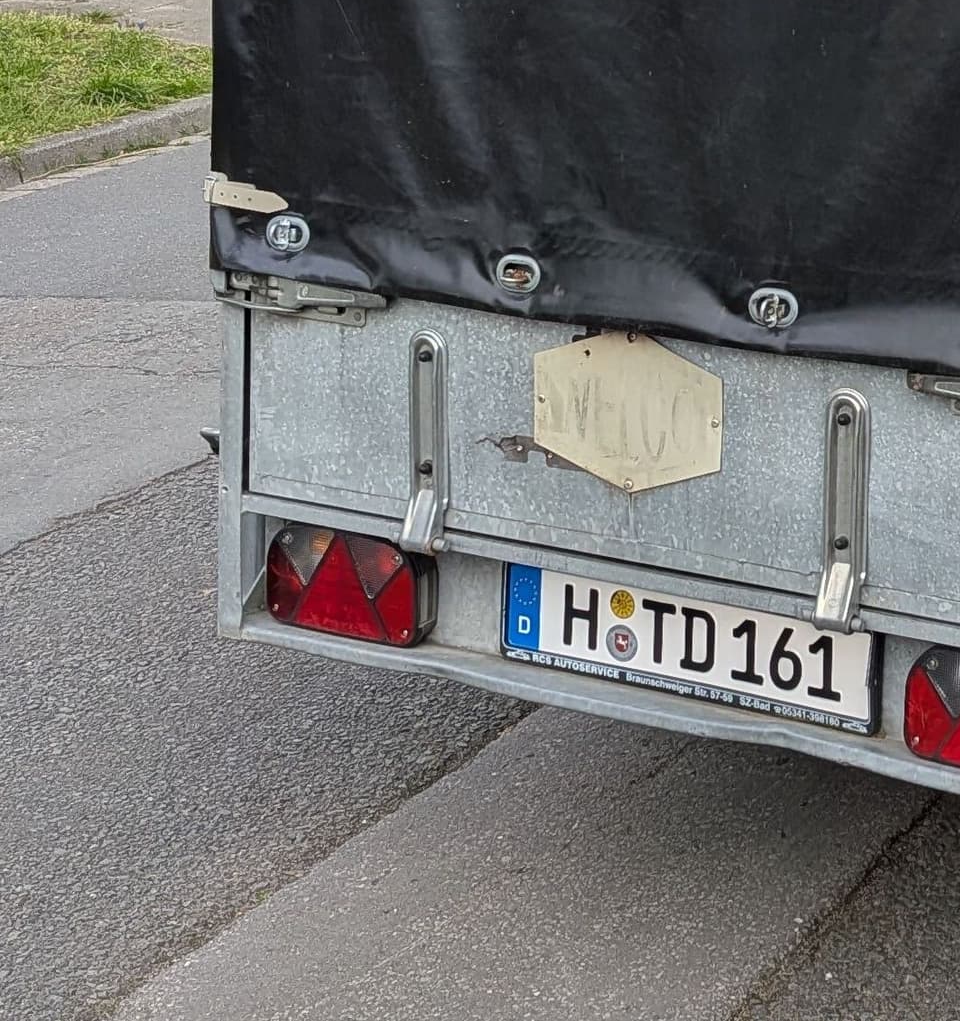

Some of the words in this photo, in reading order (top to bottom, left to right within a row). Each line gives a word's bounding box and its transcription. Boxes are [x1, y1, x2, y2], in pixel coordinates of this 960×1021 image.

[517, 615, 532, 635] D
[562, 584, 599, 651] H
[641, 598, 716, 673] TD
[731, 619, 841, 702] 161
[554, 658, 620, 680] AUTOSERVICE
[625, 671, 692, 695] Braunschweiger
[694, 685, 709, 698] Str.
